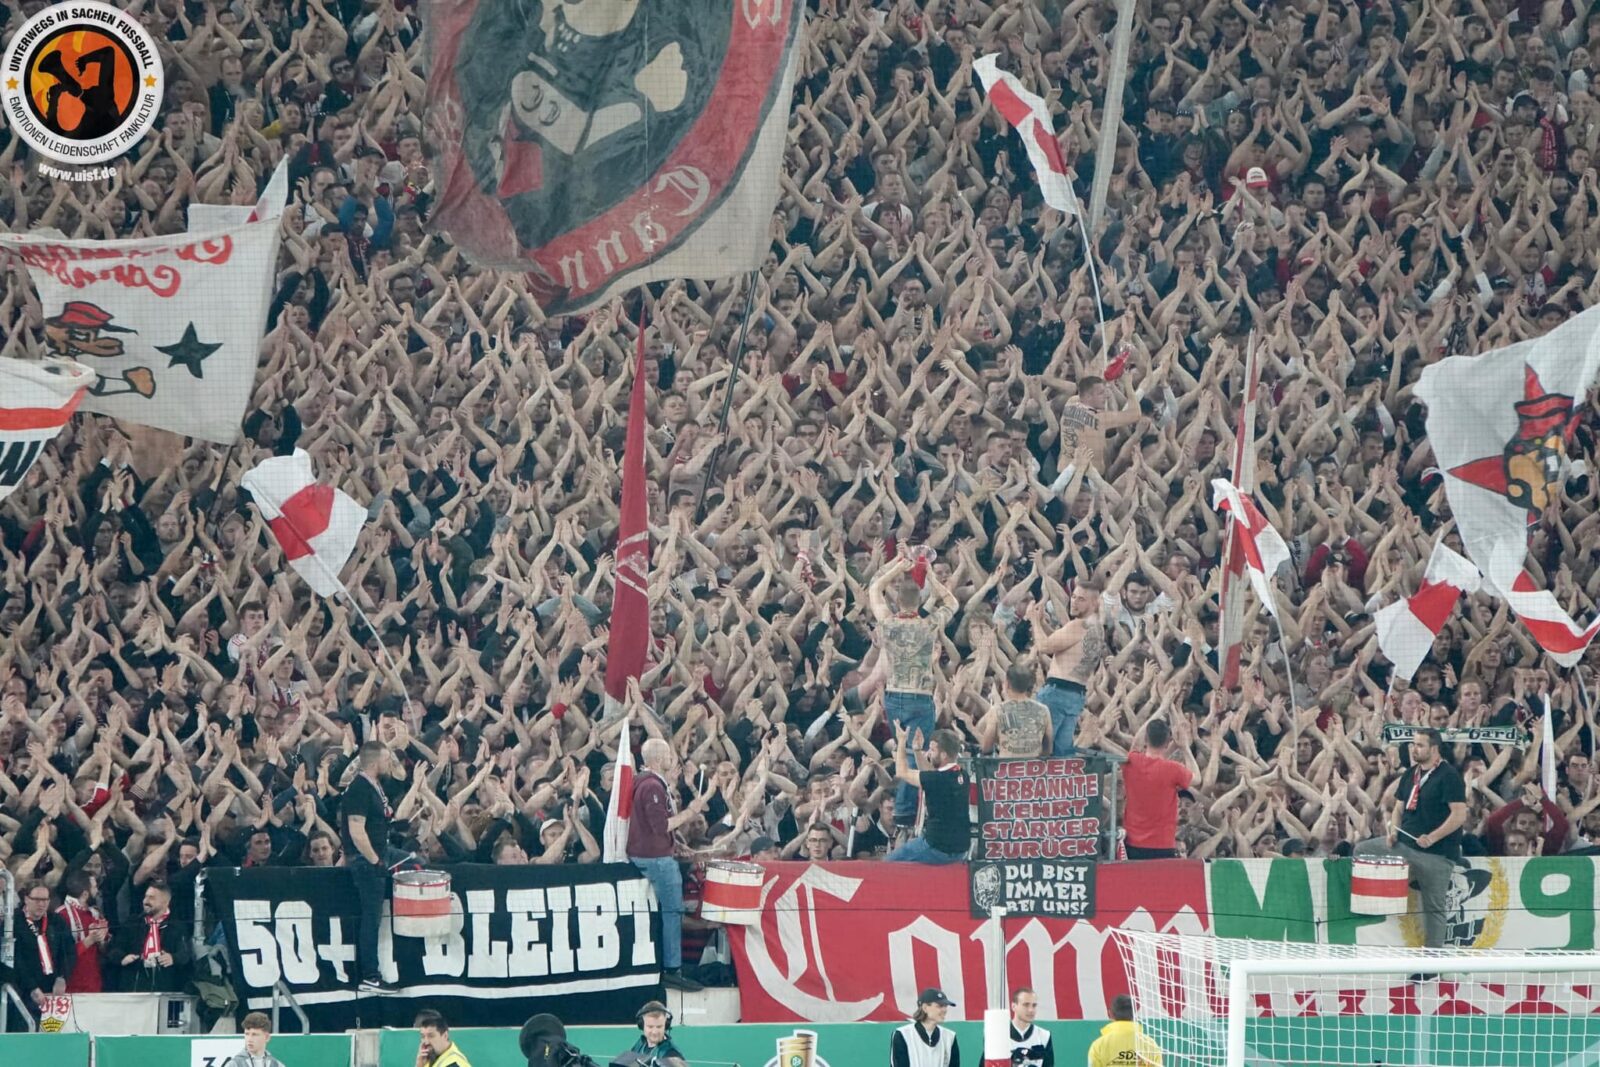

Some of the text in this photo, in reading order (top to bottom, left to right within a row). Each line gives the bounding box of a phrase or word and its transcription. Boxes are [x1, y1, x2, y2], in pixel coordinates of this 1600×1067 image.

[994, 759, 1086, 779] JEDER
[981, 774, 1099, 801] VERBANNTE
[993, 798, 1089, 820] KEHRT
[1005, 864, 1088, 881] DU BIST
[1005, 881, 1088, 900] IMMER
[1042, 900, 1089, 915] UNS!
[422, 878, 659, 978] BLEIBT
